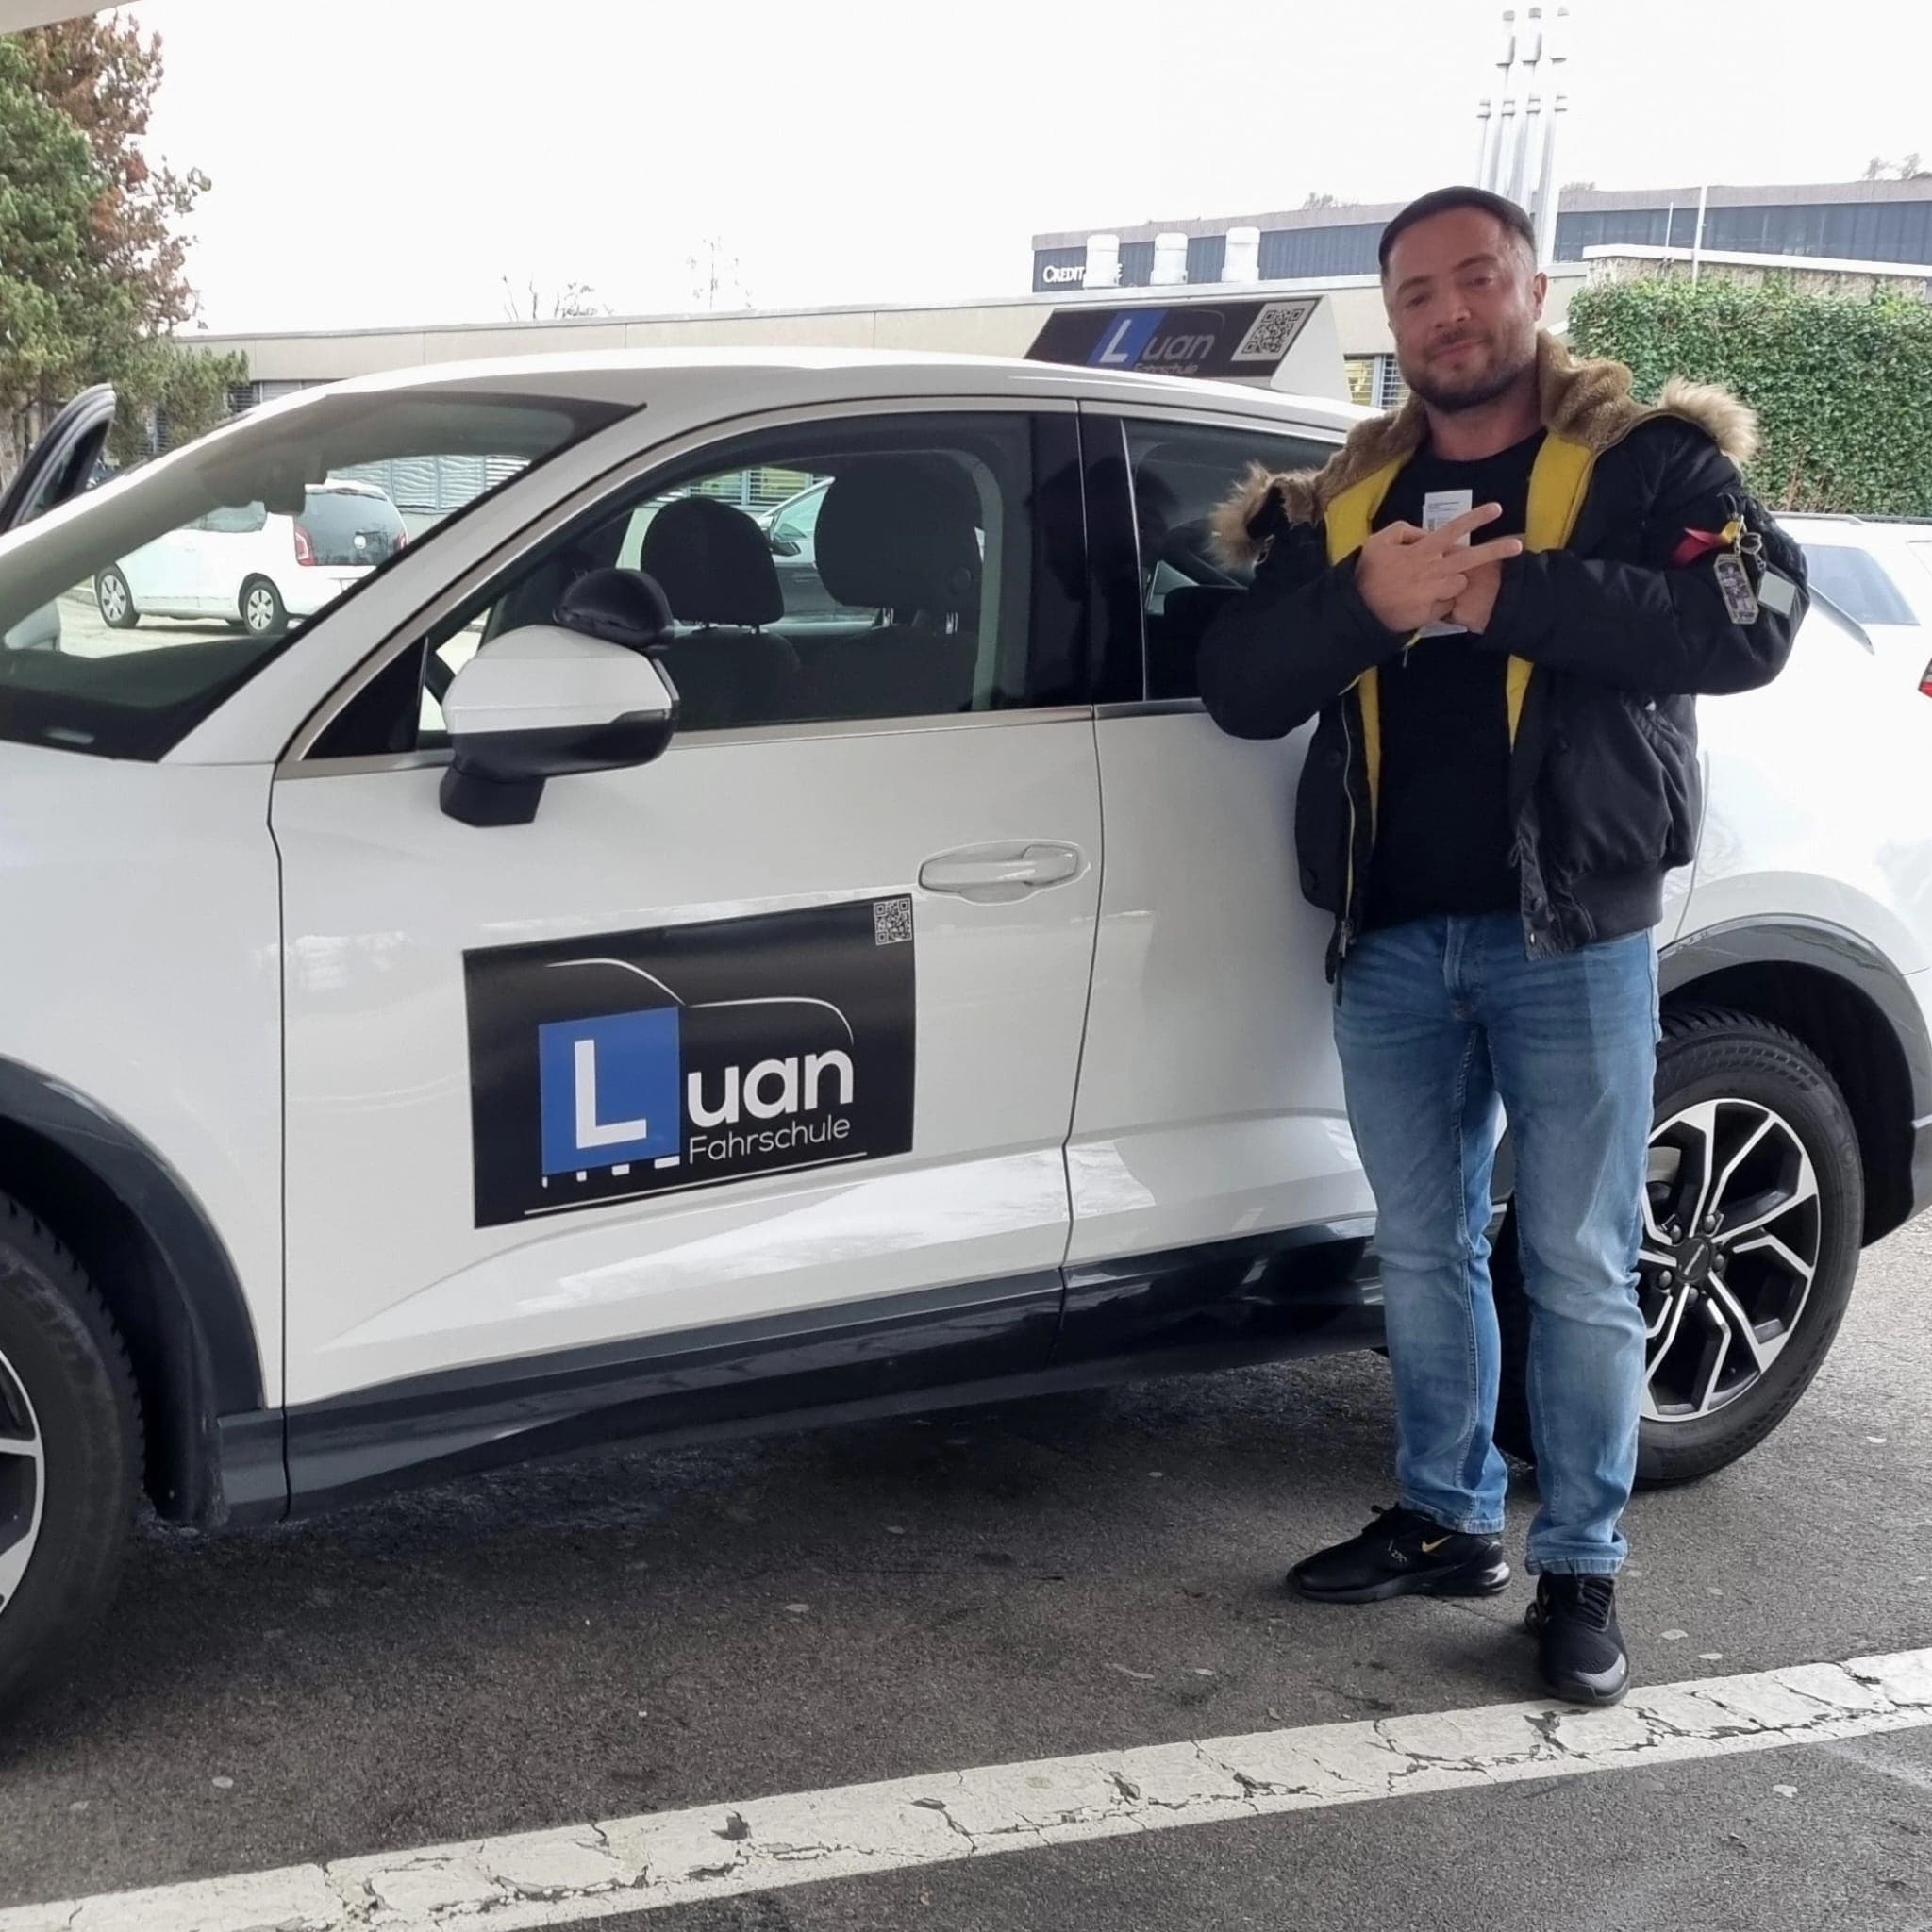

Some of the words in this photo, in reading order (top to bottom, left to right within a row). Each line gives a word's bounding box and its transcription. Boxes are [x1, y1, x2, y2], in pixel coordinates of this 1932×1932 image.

[1099, 319, 1215, 363] Luan
[574, 1039, 854, 1149] Luan
[689, 1114, 851, 1165] Fahrschule
